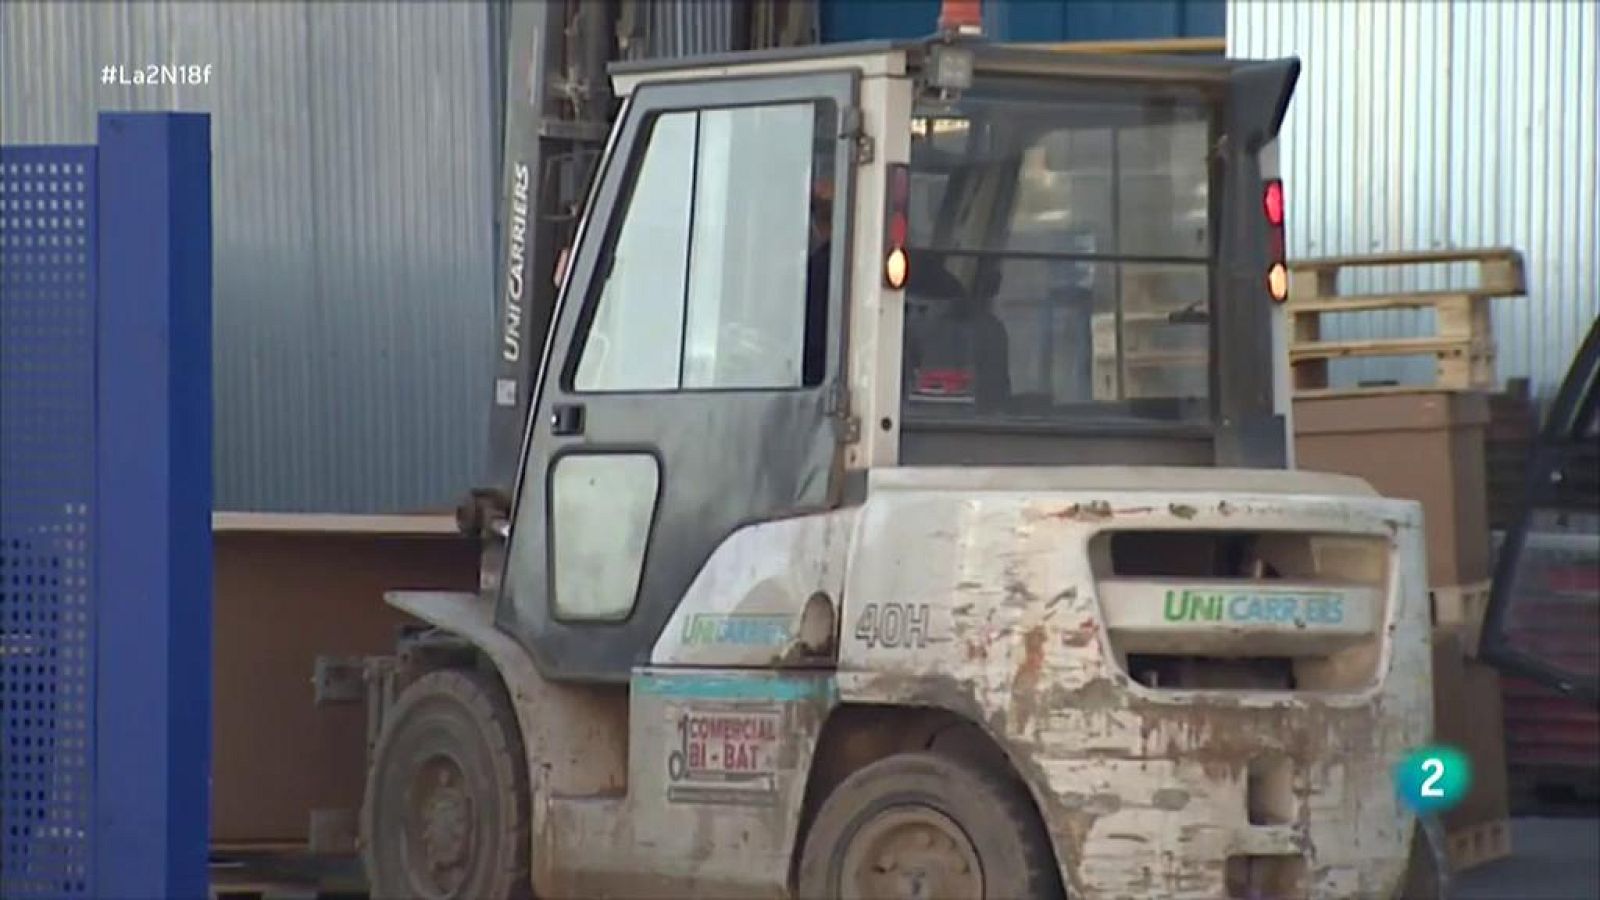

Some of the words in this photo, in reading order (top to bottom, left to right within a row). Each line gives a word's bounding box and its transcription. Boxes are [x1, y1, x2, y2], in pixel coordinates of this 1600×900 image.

[503, 162, 529, 362] UNICARRIERS
[855, 603, 928, 648] 40H
[689, 717, 776, 741] COMERCIAL
